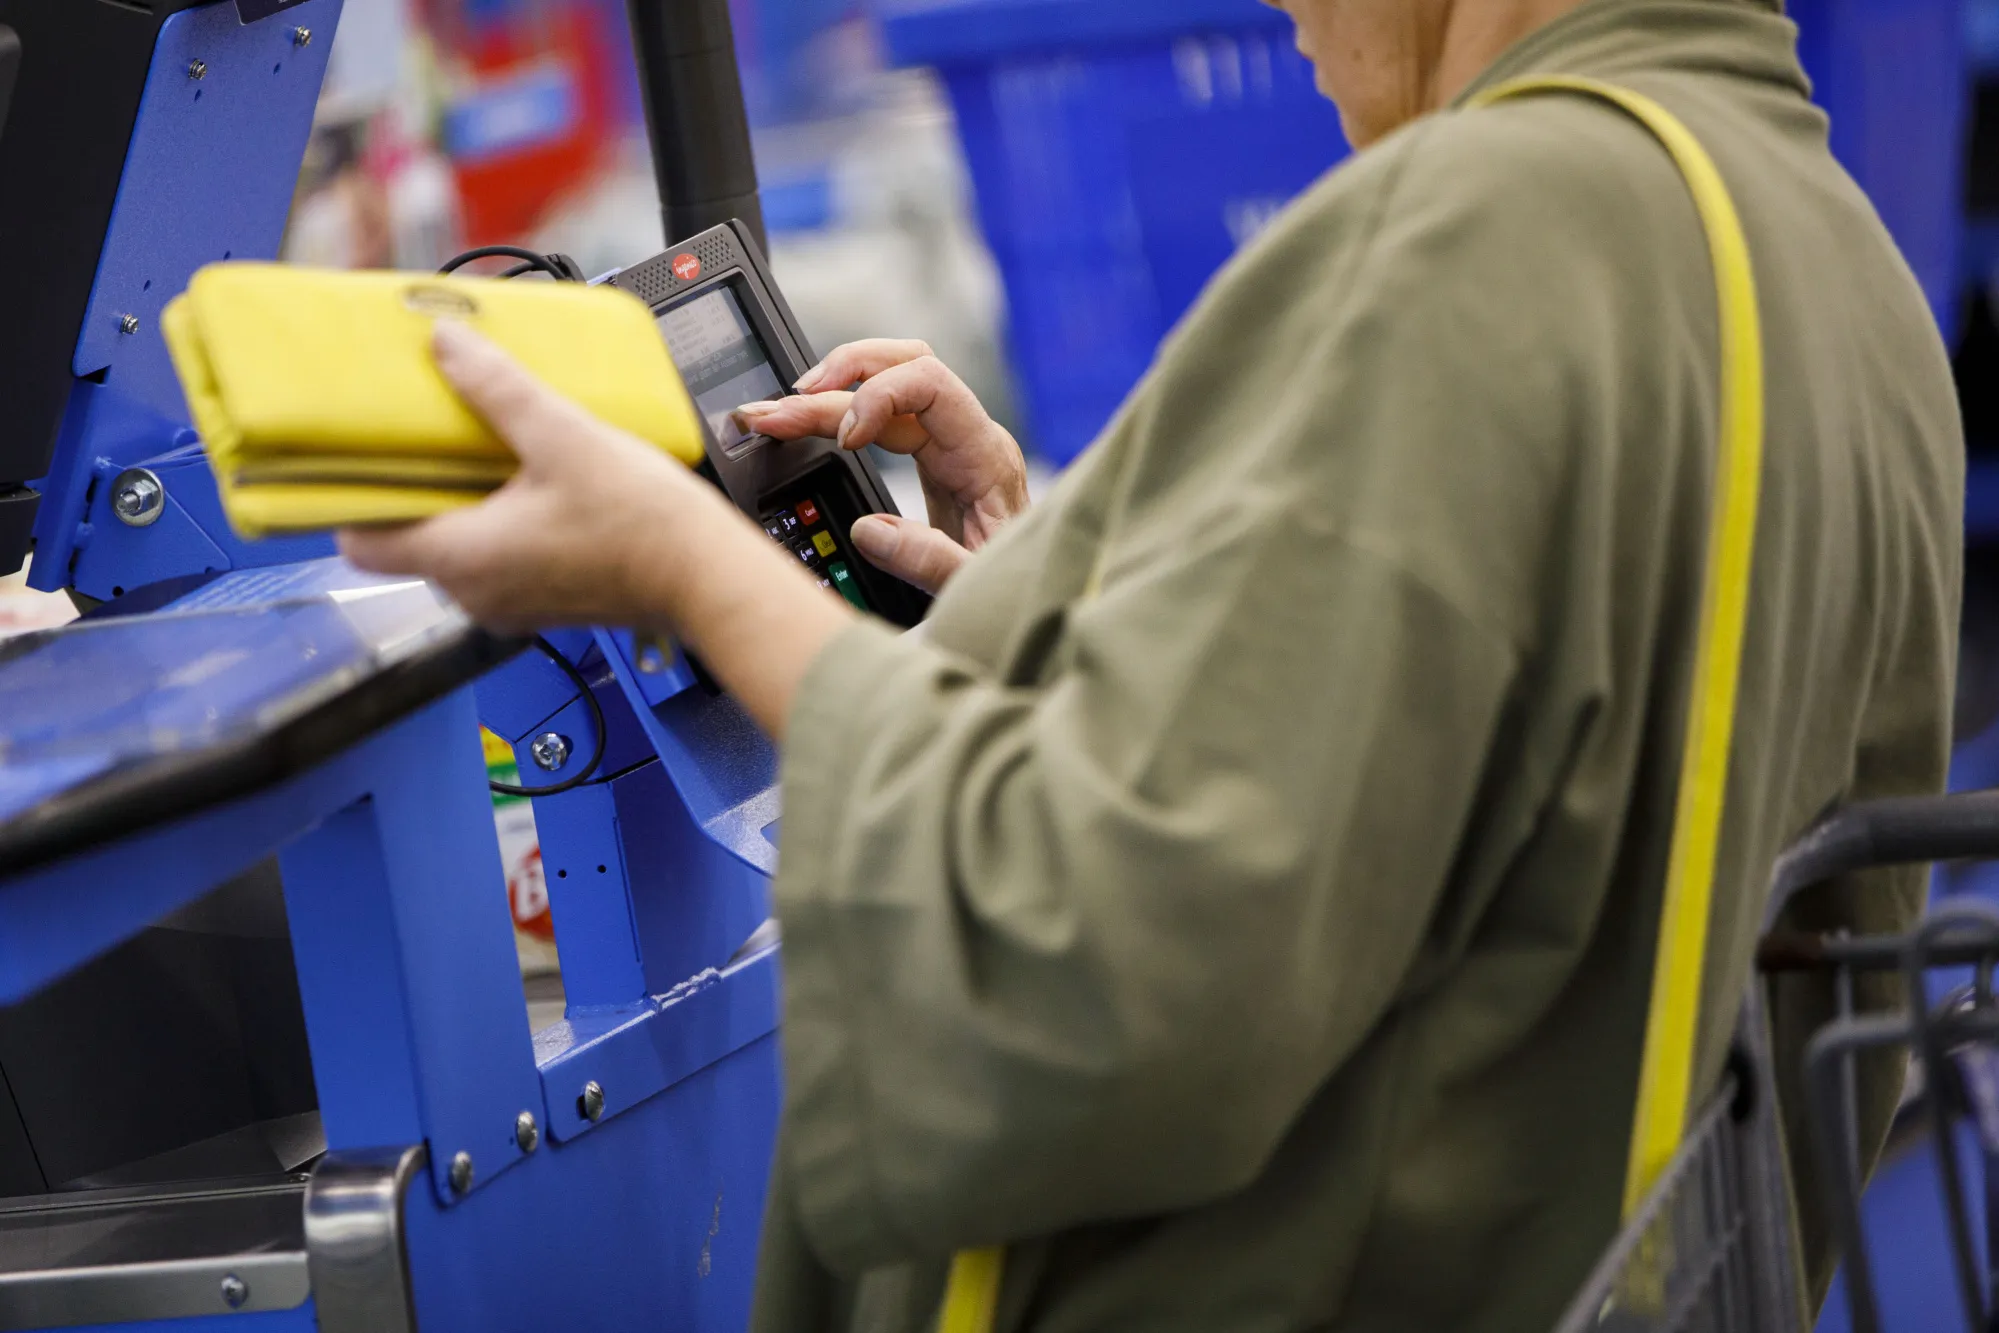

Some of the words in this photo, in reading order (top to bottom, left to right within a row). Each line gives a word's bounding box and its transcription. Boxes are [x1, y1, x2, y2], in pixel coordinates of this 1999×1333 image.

[783, 518, 791, 530] 3
[800, 549, 808, 561] 6
[835, 569, 849, 582] Enter
